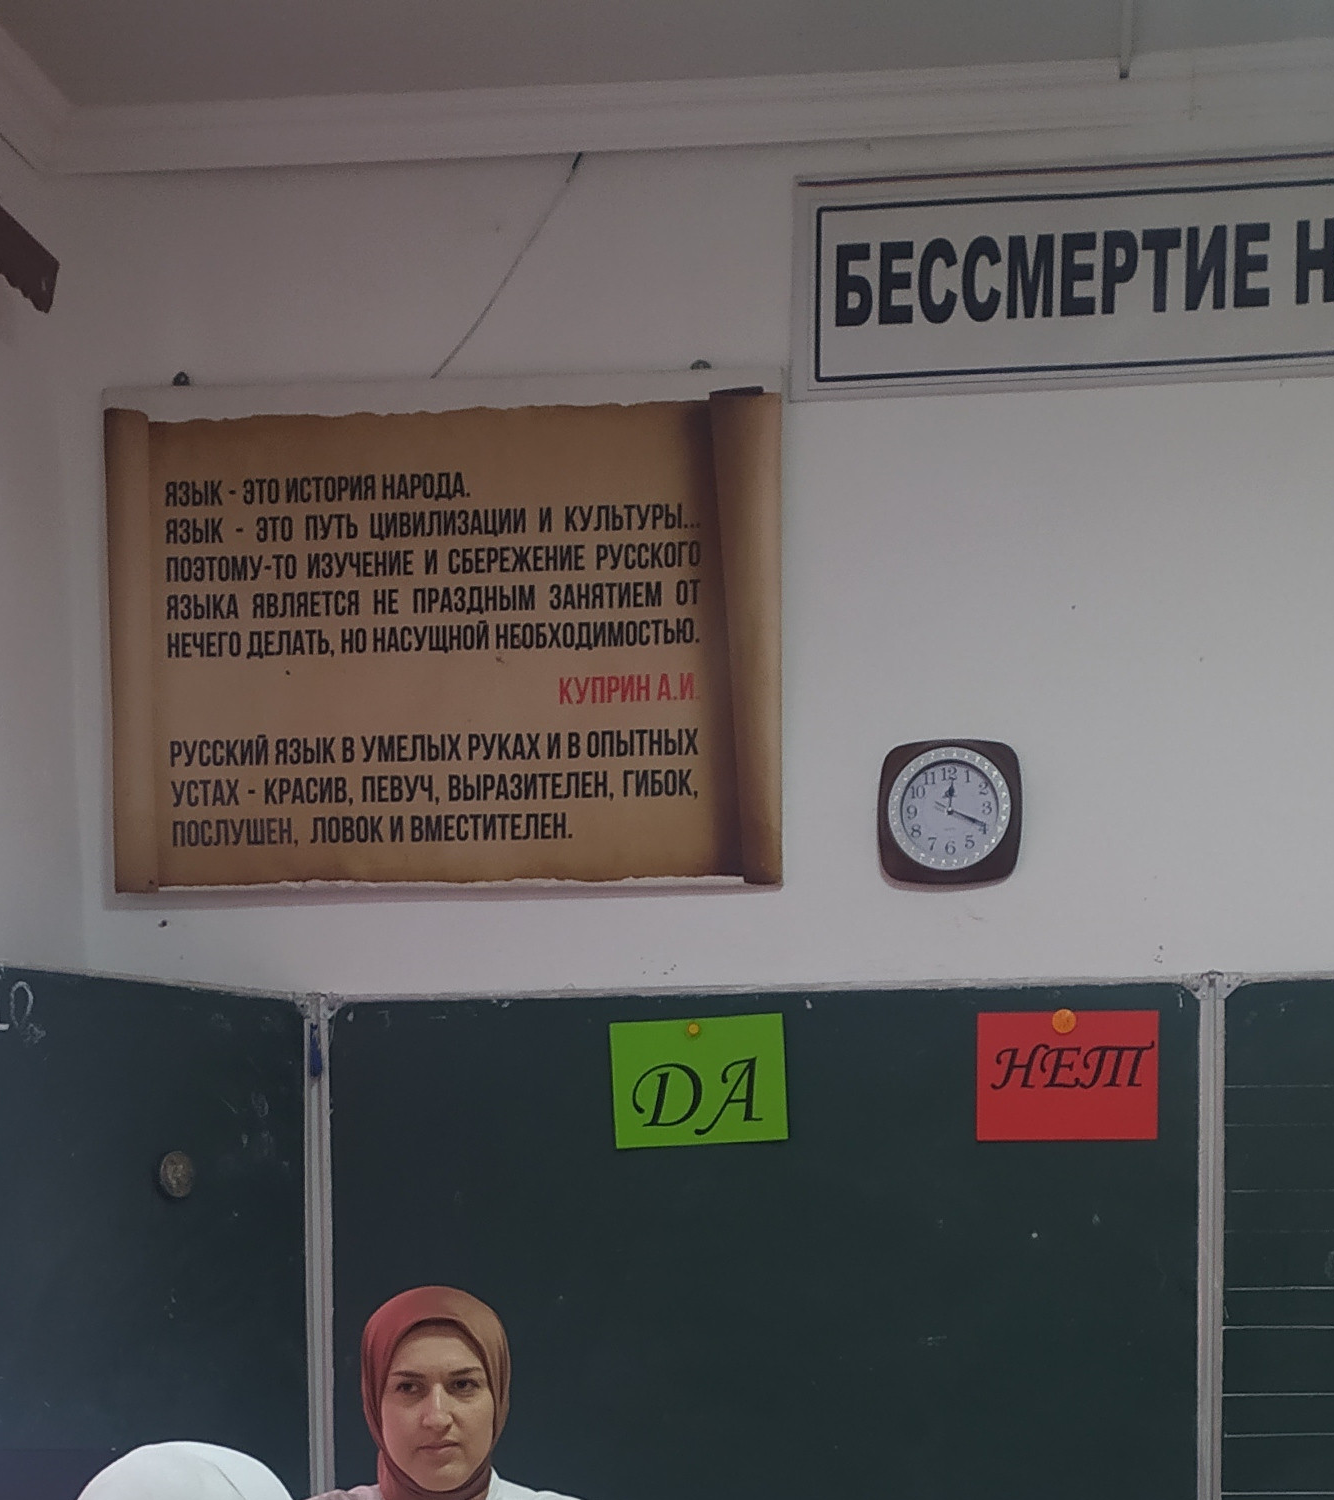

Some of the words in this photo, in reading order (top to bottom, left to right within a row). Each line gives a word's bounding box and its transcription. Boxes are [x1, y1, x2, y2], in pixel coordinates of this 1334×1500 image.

[835, 222, 1270, 327] БЕССМЕРТИЕ
[165, 479, 223, 507] ЯЗЫК
[243, 478, 280, 505] ЭТО
[286, 474, 376, 502] ИСТОРИЯ
[382, 472, 471, 501] НАРОДА.
[166, 517, 224, 544] ЯЗЫК
[256, 516, 293, 543] ЭТО
[305, 512, 358, 541] ПУТЬ
[370, 507, 527, 541] ЦИВИЛИЗАЦИИ
[539, 506, 552, 533] И
[564, 503, 701, 532] КУЛЬТУРЫ...
[166, 554, 297, 582] ПОЭТОМУ-ТО
[307, 549, 414, 579] ИЗУЧЕНИЕ
[424, 549, 438, 575] И
[448, 544, 585, 575] СБЕРЕЖЕНИЕ
[596, 540, 701, 570] РУССКОГО
[167, 594, 239, 620] ЯЗЫКА
[252, 590, 360, 619] ЯВЛЯЕТСЯ
[373, 588, 399, 615] НЕ
[413, 584, 536, 614] ПРАЗДНЫМ
[550, 581, 662, 610] ЗАНЯТИЕМ
[676, 578, 701, 606] ОТ
[167, 631, 241, 658] НЕЧЕГО
[246, 629, 335, 659] ДЕЛАТЬ,
[341, 628, 367, 654] НО
[372, 620, 490, 653] НАСУЩНОЙ
[495, 617, 700, 650] НЕОБХОДИМОСТЬЮ.
[559, 674, 650, 705] КУПРИН
[170, 734, 269, 767] РУССКИЙ
[275, 736, 336, 765] ЯЗЫК
[342, 736, 355, 763] В
[361, 733, 461, 763] УМЕЛЫХ
[468, 733, 541, 761] РУКАХ
[547, 733, 561, 759] И
[568, 732, 581, 758] В
[587, 728, 699, 758] ОПЫТНЫХ
[171, 779, 240, 807] УСТАХ
[264, 777, 354, 806] КРАСИВ,
[362, 775, 440, 806] ПЕВУЧ,
[448, 770, 614, 802] ВЫРАЗИТЕЛЕН,
[623, 769, 699, 799] ГИБОК,
[172, 817, 299, 848] ПОСЛУШЕН,
[310, 815, 383, 844] ЛОВОК
[390, 815, 404, 842] И
[411, 812, 573, 842] ВМЕСТИТЕЛЕН.
[990, 1040, 1155, 1091] НЕТ
[632, 1056, 763, 1136] ДА
